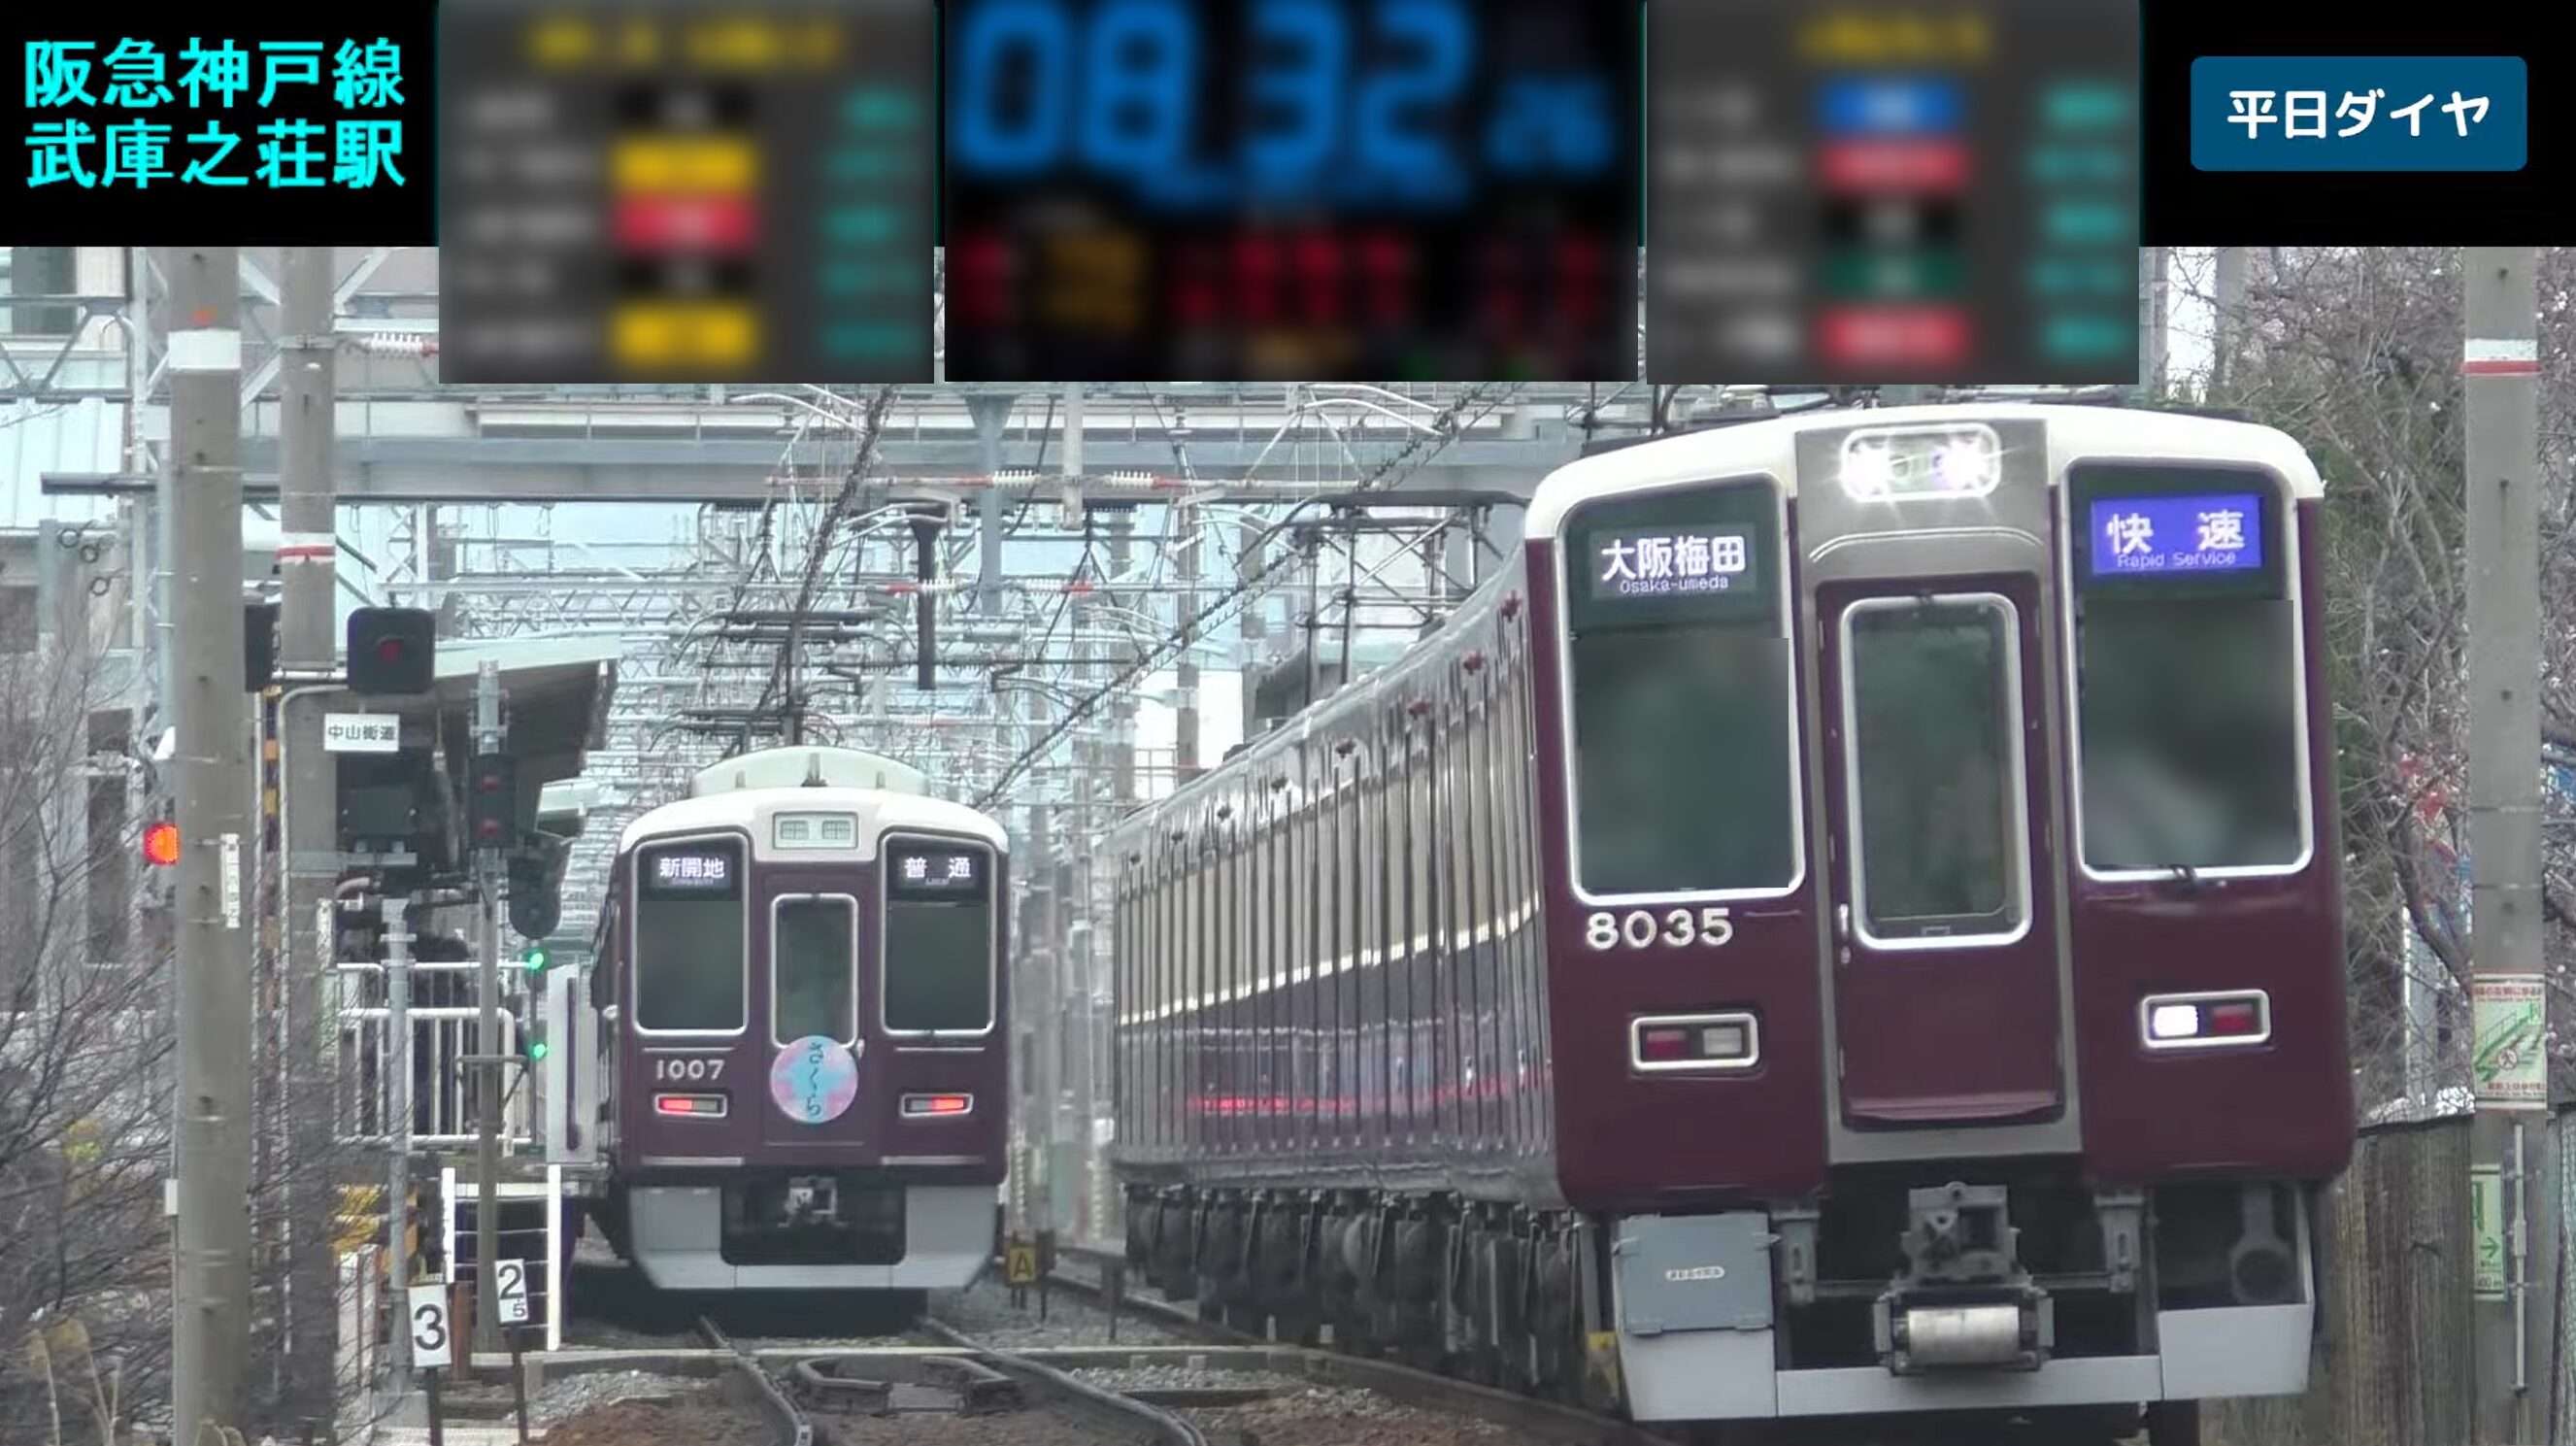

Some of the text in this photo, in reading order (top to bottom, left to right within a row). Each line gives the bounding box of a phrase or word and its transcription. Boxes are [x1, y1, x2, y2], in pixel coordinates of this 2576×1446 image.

[1601, 535, 1746, 581] 大阪梅田
[2117, 551, 2236, 569] Rapid Service
[659, 858, 724, 878] 新開地
[1587, 907, 1733, 950] 8035
[657, 1059, 724, 1080] 1007
[807, 1042, 824, 1117] さくら
[498, 1263, 524, 1300] 2
[1013, 1251, 1033, 1278] A
[414, 1303, 447, 1351] 3
